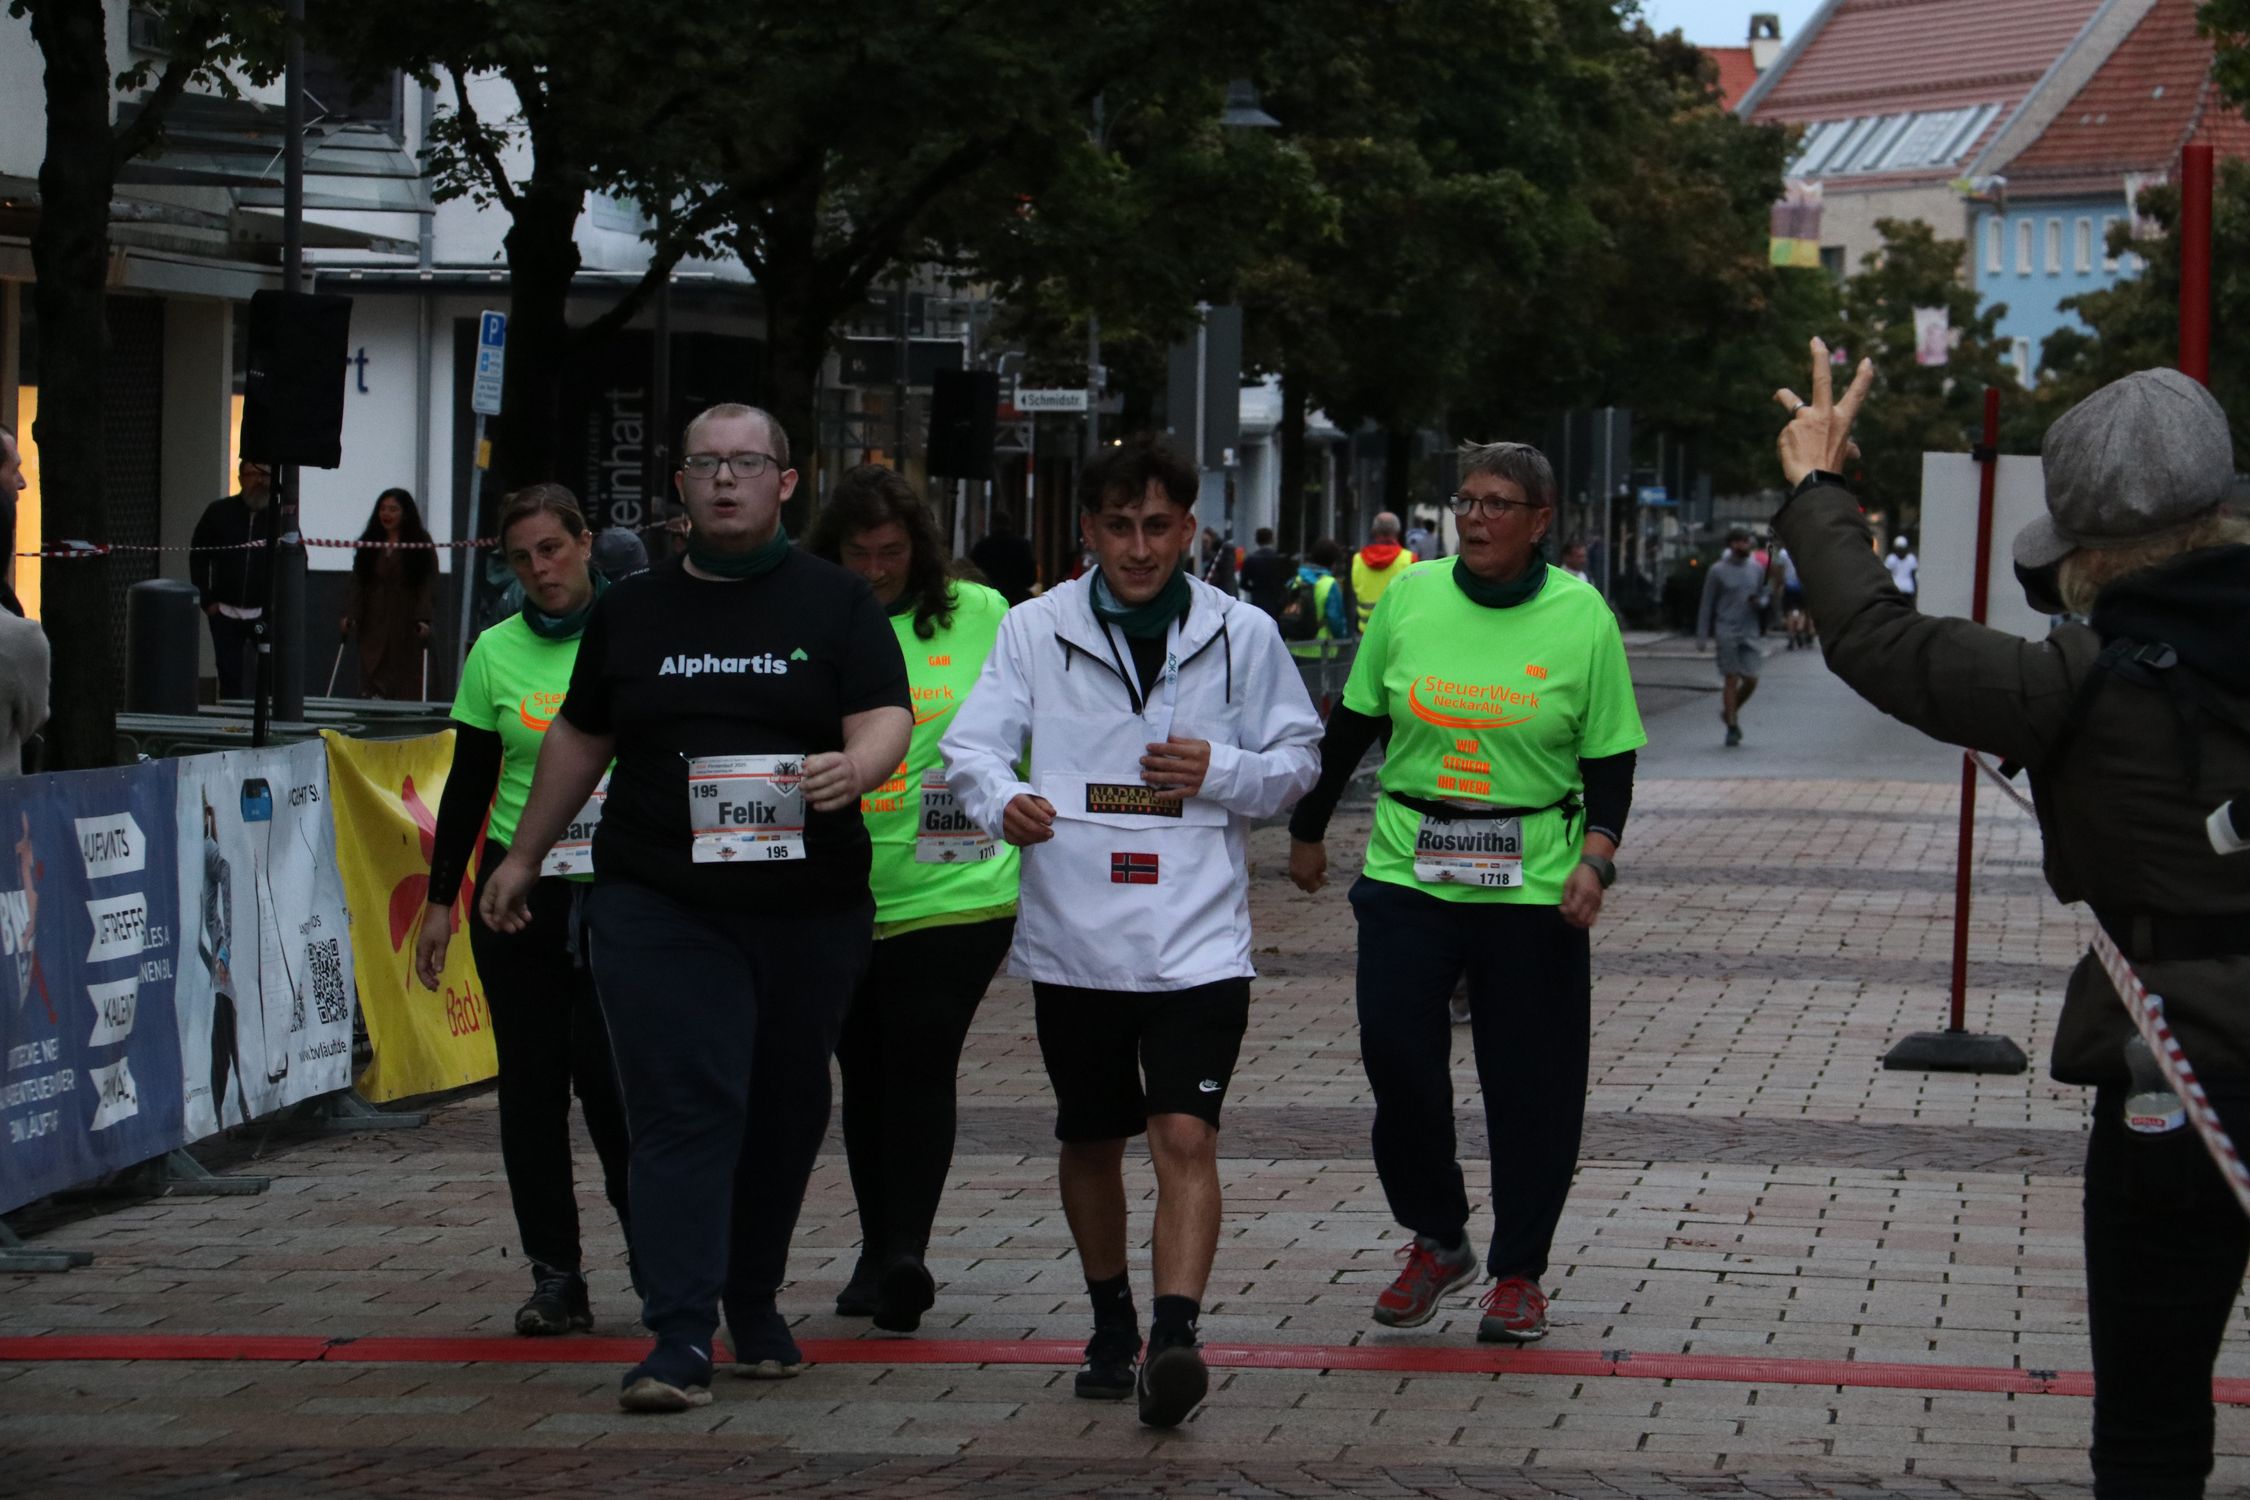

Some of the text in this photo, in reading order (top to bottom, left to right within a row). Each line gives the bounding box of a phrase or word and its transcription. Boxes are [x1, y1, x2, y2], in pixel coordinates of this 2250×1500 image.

[488, 317, 499, 343] P
[658, 652, 788, 678] Alphartis
[928, 656, 950, 667] GABI
[1525, 664, 1548, 680] ROSI
[1424, 676, 1540, 709] SteuerWerk
[1433, 694, 1503, 715] NeckarAlb
[1456, 739, 1480, 754] WIR
[1443, 755, 1491, 774] STEUERN
[692, 784, 718, 799] 195
[1437, 775, 1491, 796] IHR WERK
[719, 801, 776, 824] Felix
[1418, 829, 1516, 852] Roswitha
[767, 846, 788, 859] 195
[1480, 873, 1509, 885] 1718
